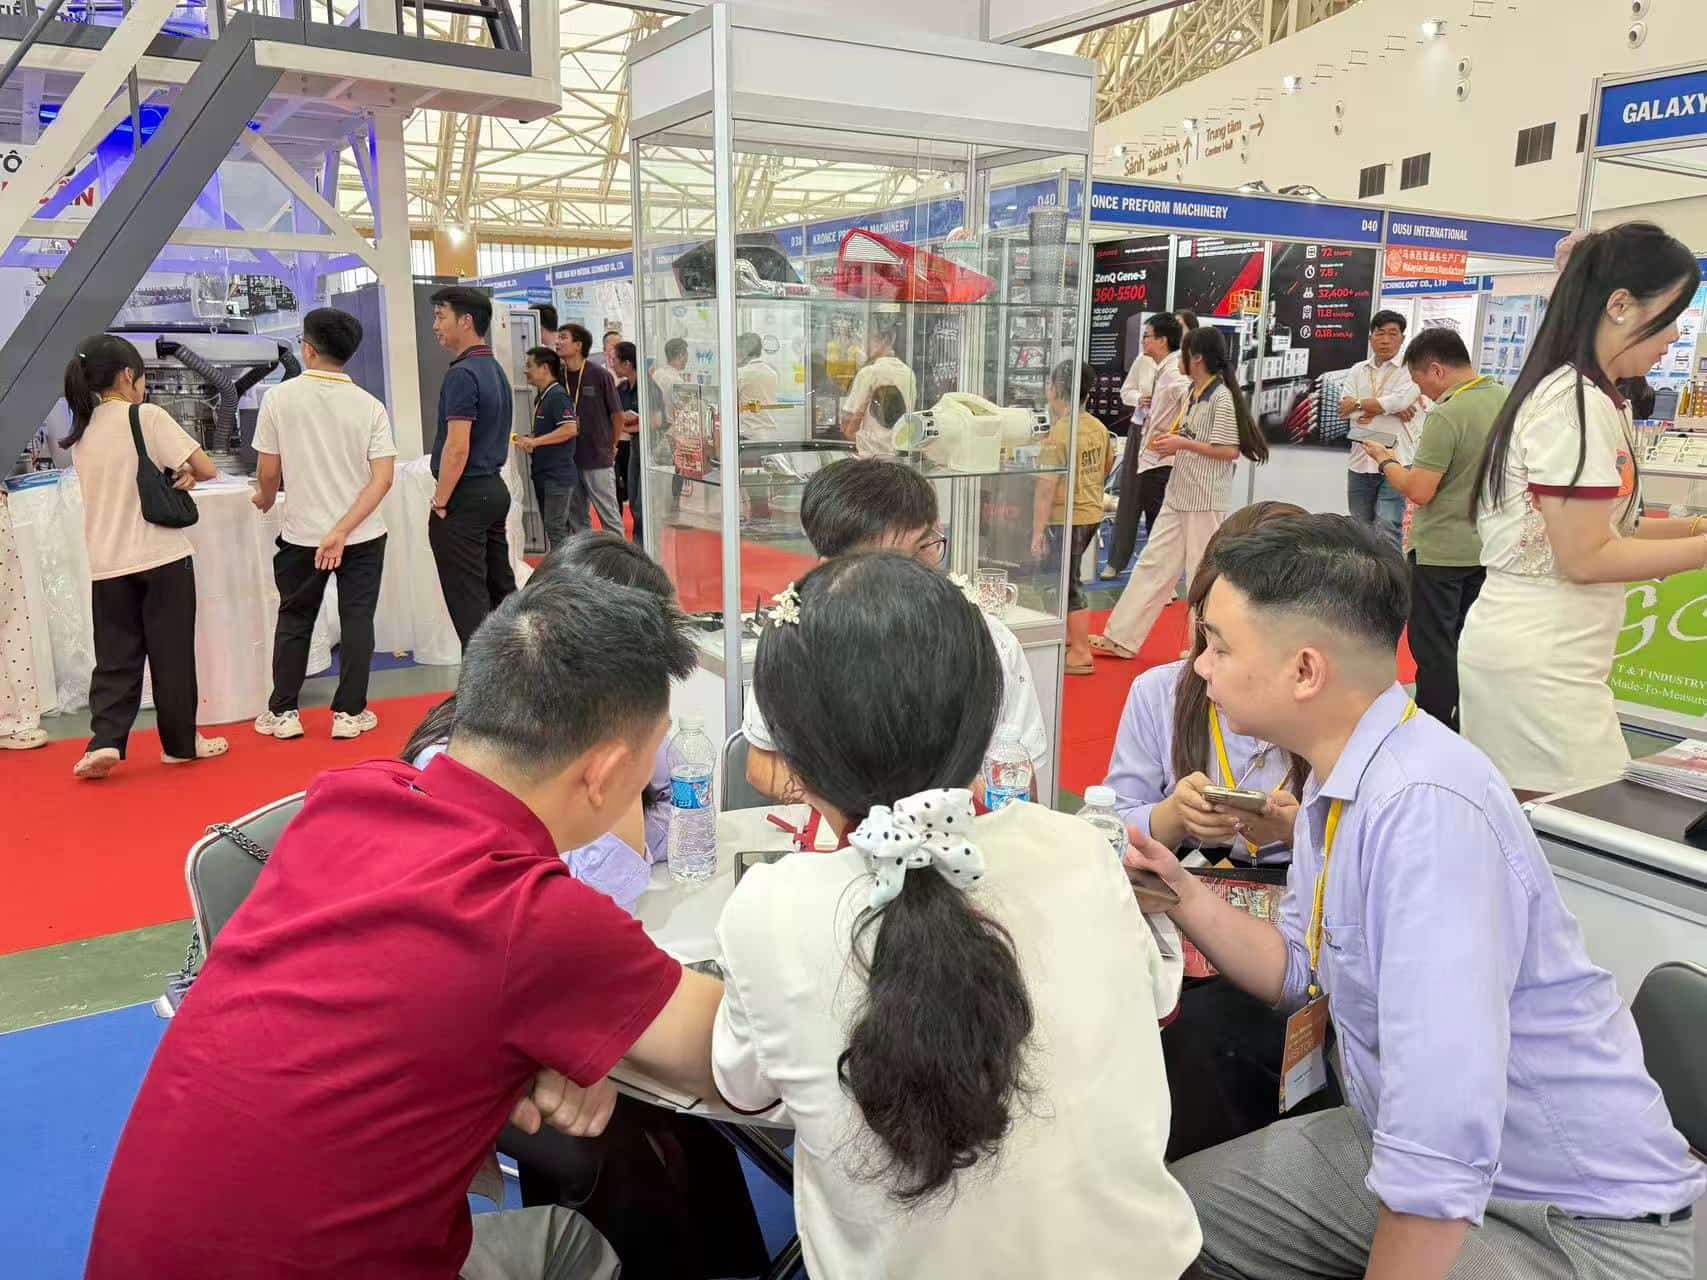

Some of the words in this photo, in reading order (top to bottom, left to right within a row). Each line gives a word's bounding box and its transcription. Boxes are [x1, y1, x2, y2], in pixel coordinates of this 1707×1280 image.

[1622, 92, 1707, 124] GALAXY
[1206, 127, 1227, 142] Trung
[1227, 119, 1242, 135] tâm
[1122, 196, 1170, 215] PREFORM
[1172, 201, 1229, 220] MACHINERY
[869, 218, 910, 235] MACHINERY
[1361, 219, 1378, 232] D40
[1392, 223, 1412, 236] OUSU
[1413, 225, 1468, 241] INTERNATIONAL
[1094, 272, 1116, 284] ZenQ
[1117, 269, 1147, 283] Gene-3
[1617, 663, 1625, 673] T
[1626, 665, 1637, 676] &
[1640, 668, 1648, 678] T
[1648, 670, 1707, 689] INDUSTRY
[1610, 677, 1707, 706] Made-To-Measure
